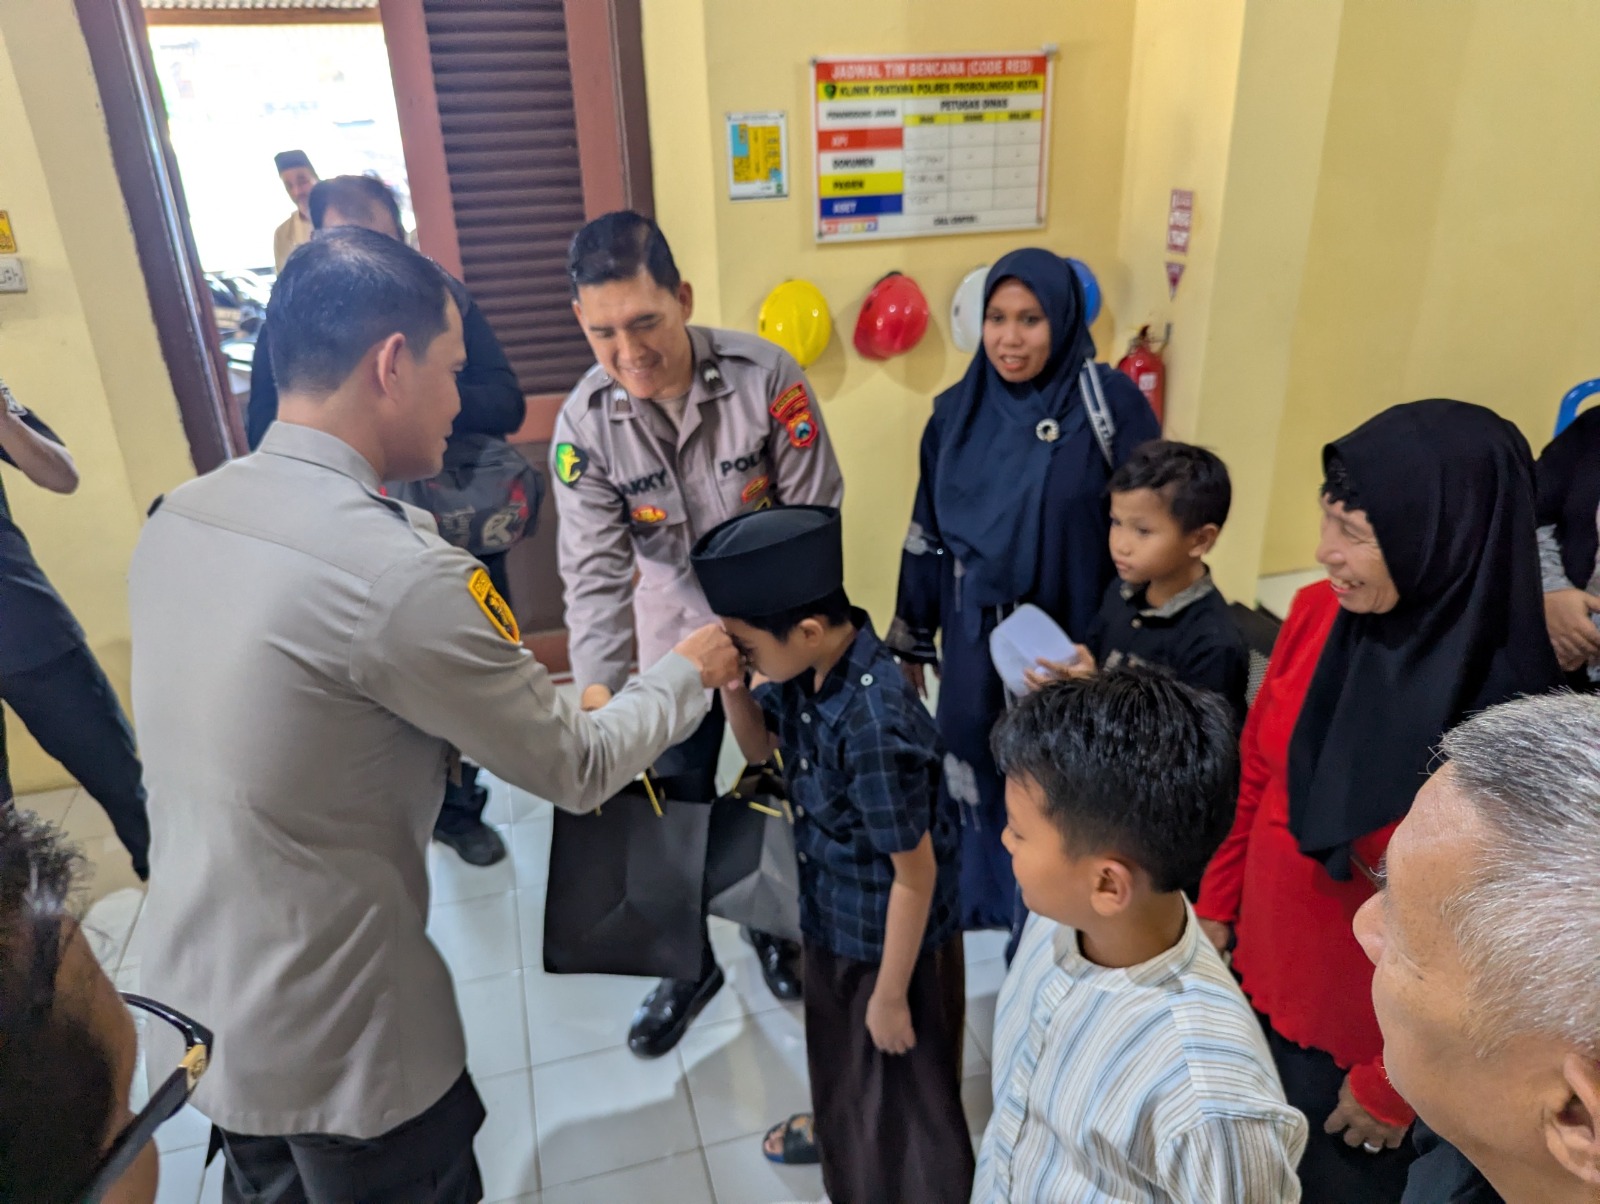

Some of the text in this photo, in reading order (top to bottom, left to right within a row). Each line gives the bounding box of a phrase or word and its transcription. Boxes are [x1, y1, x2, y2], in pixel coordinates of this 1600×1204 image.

[832, 58, 1034, 80] JADWAL TIM BENCANA (CODE RED)
[840, 86, 870, 96] KLINIK
[917, 83, 950, 94] POLRES
[953, 81, 1014, 93] PROBOLINGGO
[1017, 79, 1038, 90] KOTA
[940, 100, 980, 111] PETUGAS
[832, 157, 875, 169] DOKUMEN
[832, 180, 864, 191] PASIEN
